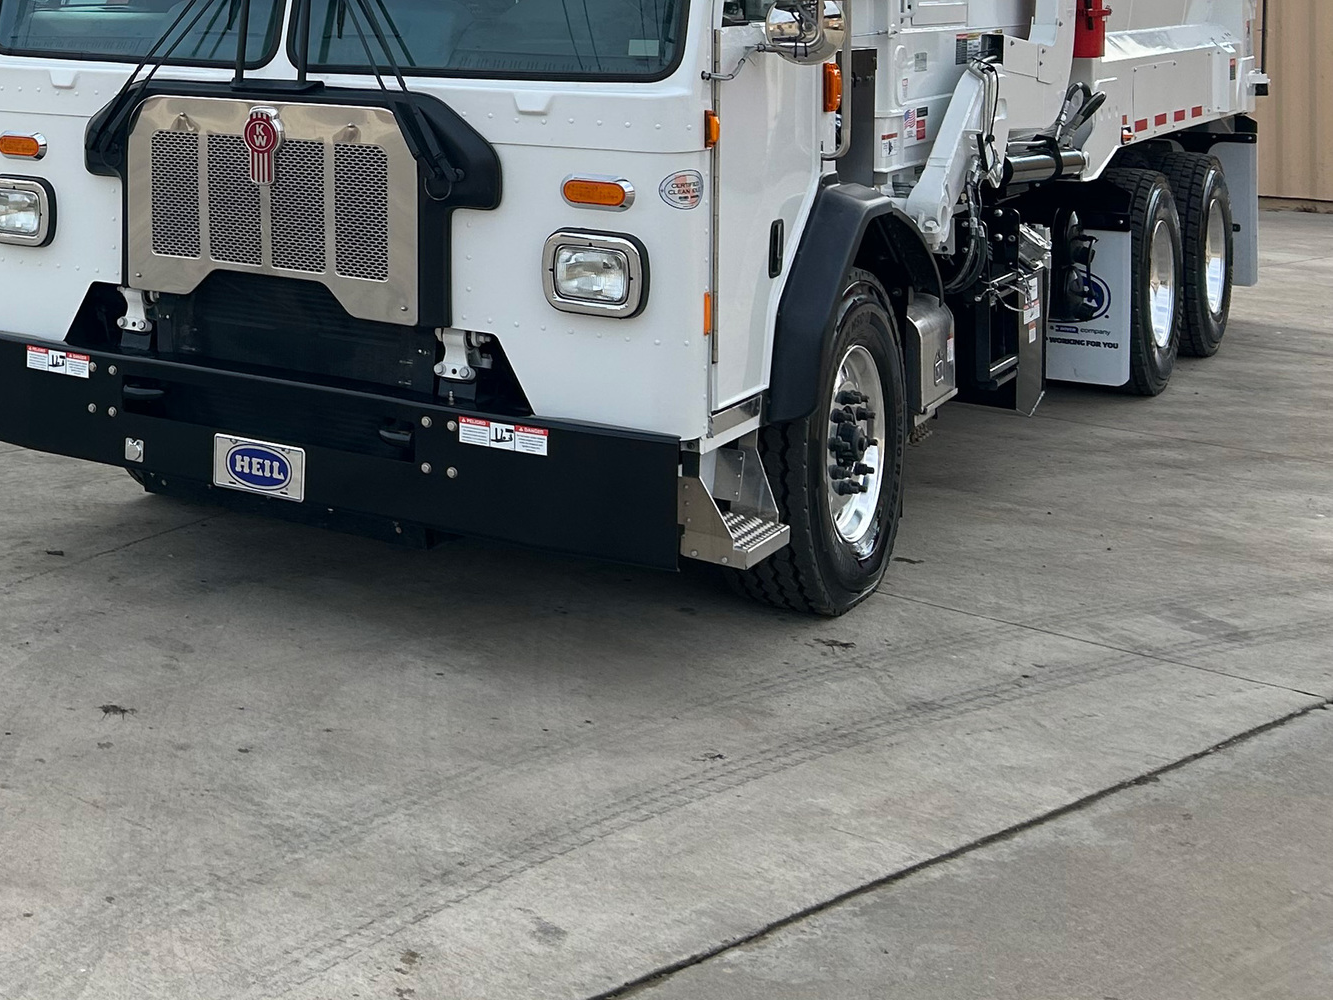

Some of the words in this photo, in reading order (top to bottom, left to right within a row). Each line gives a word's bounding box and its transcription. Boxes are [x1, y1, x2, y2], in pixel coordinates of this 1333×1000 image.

[1080, 327, 1111, 336] company
[1049, 336, 1086, 347] WORKING
[1086, 339, 1102, 348] FOR
[1102, 341, 1119, 349] YOU
[235, 455, 285, 480] HEIL
